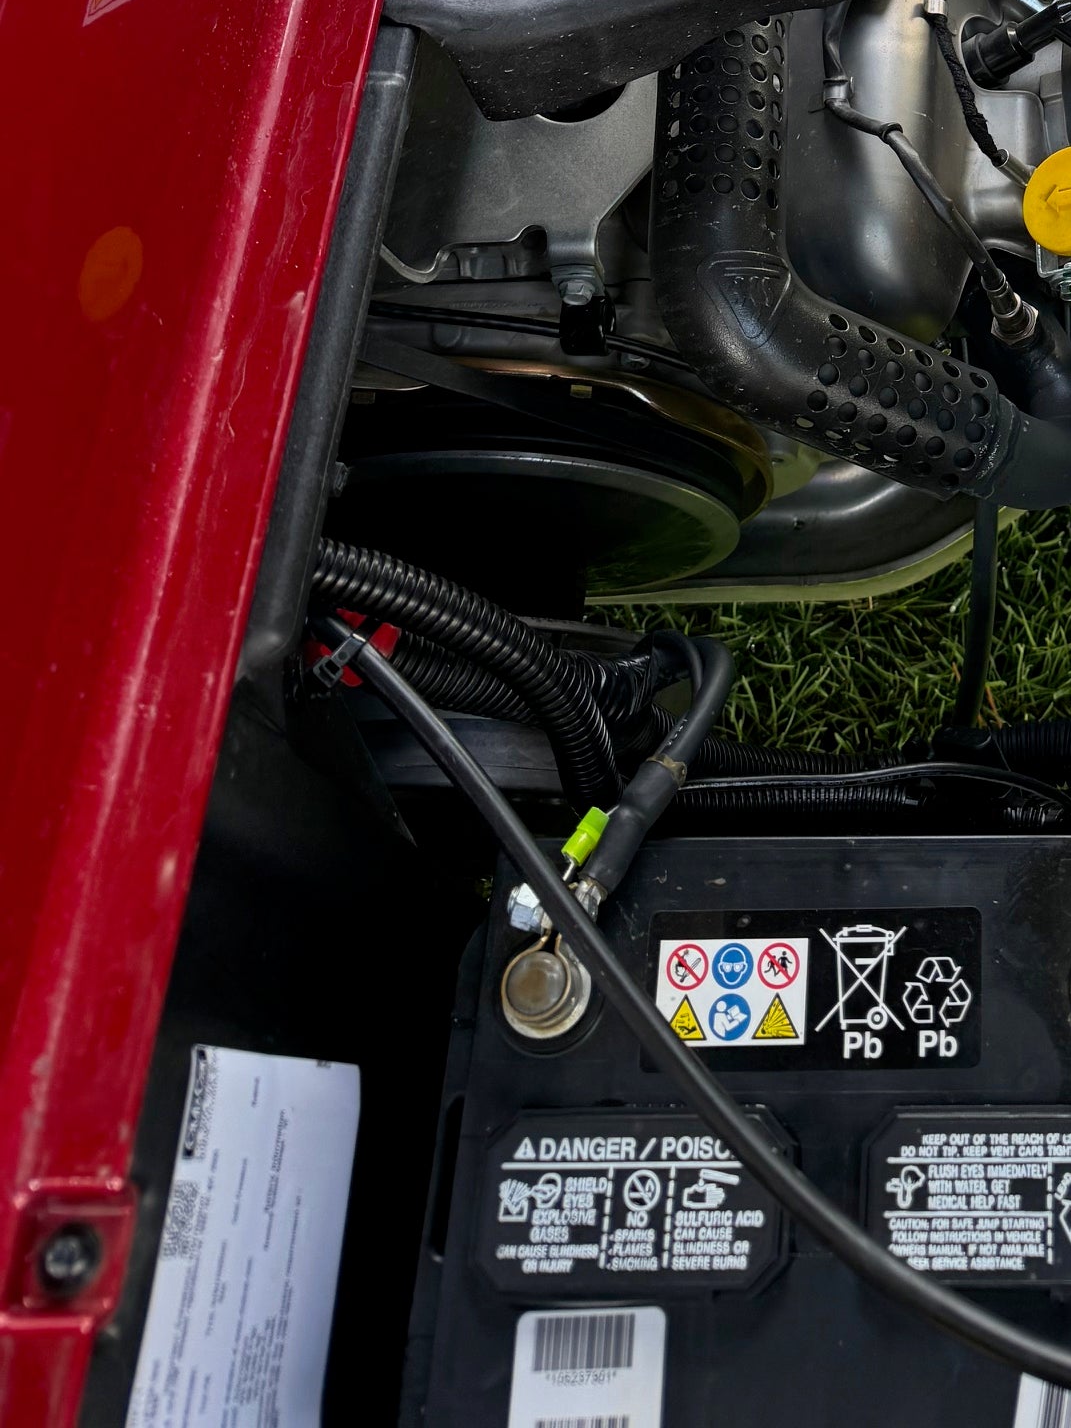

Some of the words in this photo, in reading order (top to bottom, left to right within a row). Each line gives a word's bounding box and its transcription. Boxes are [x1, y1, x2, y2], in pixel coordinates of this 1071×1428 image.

[843, 1031, 883, 1059] Pb
[918, 1030, 958, 1057] Pb
[539, 1137, 636, 1160] DANGER
[640, 1138, 657, 1160] /
[928, 1164, 958, 1178] FLUSH
[960, 1164, 984, 1178] EYES
[626, 1212, 648, 1227] NO
[674, 1211, 732, 1227] SULFURIC
[736, 1211, 764, 1226] ACID
